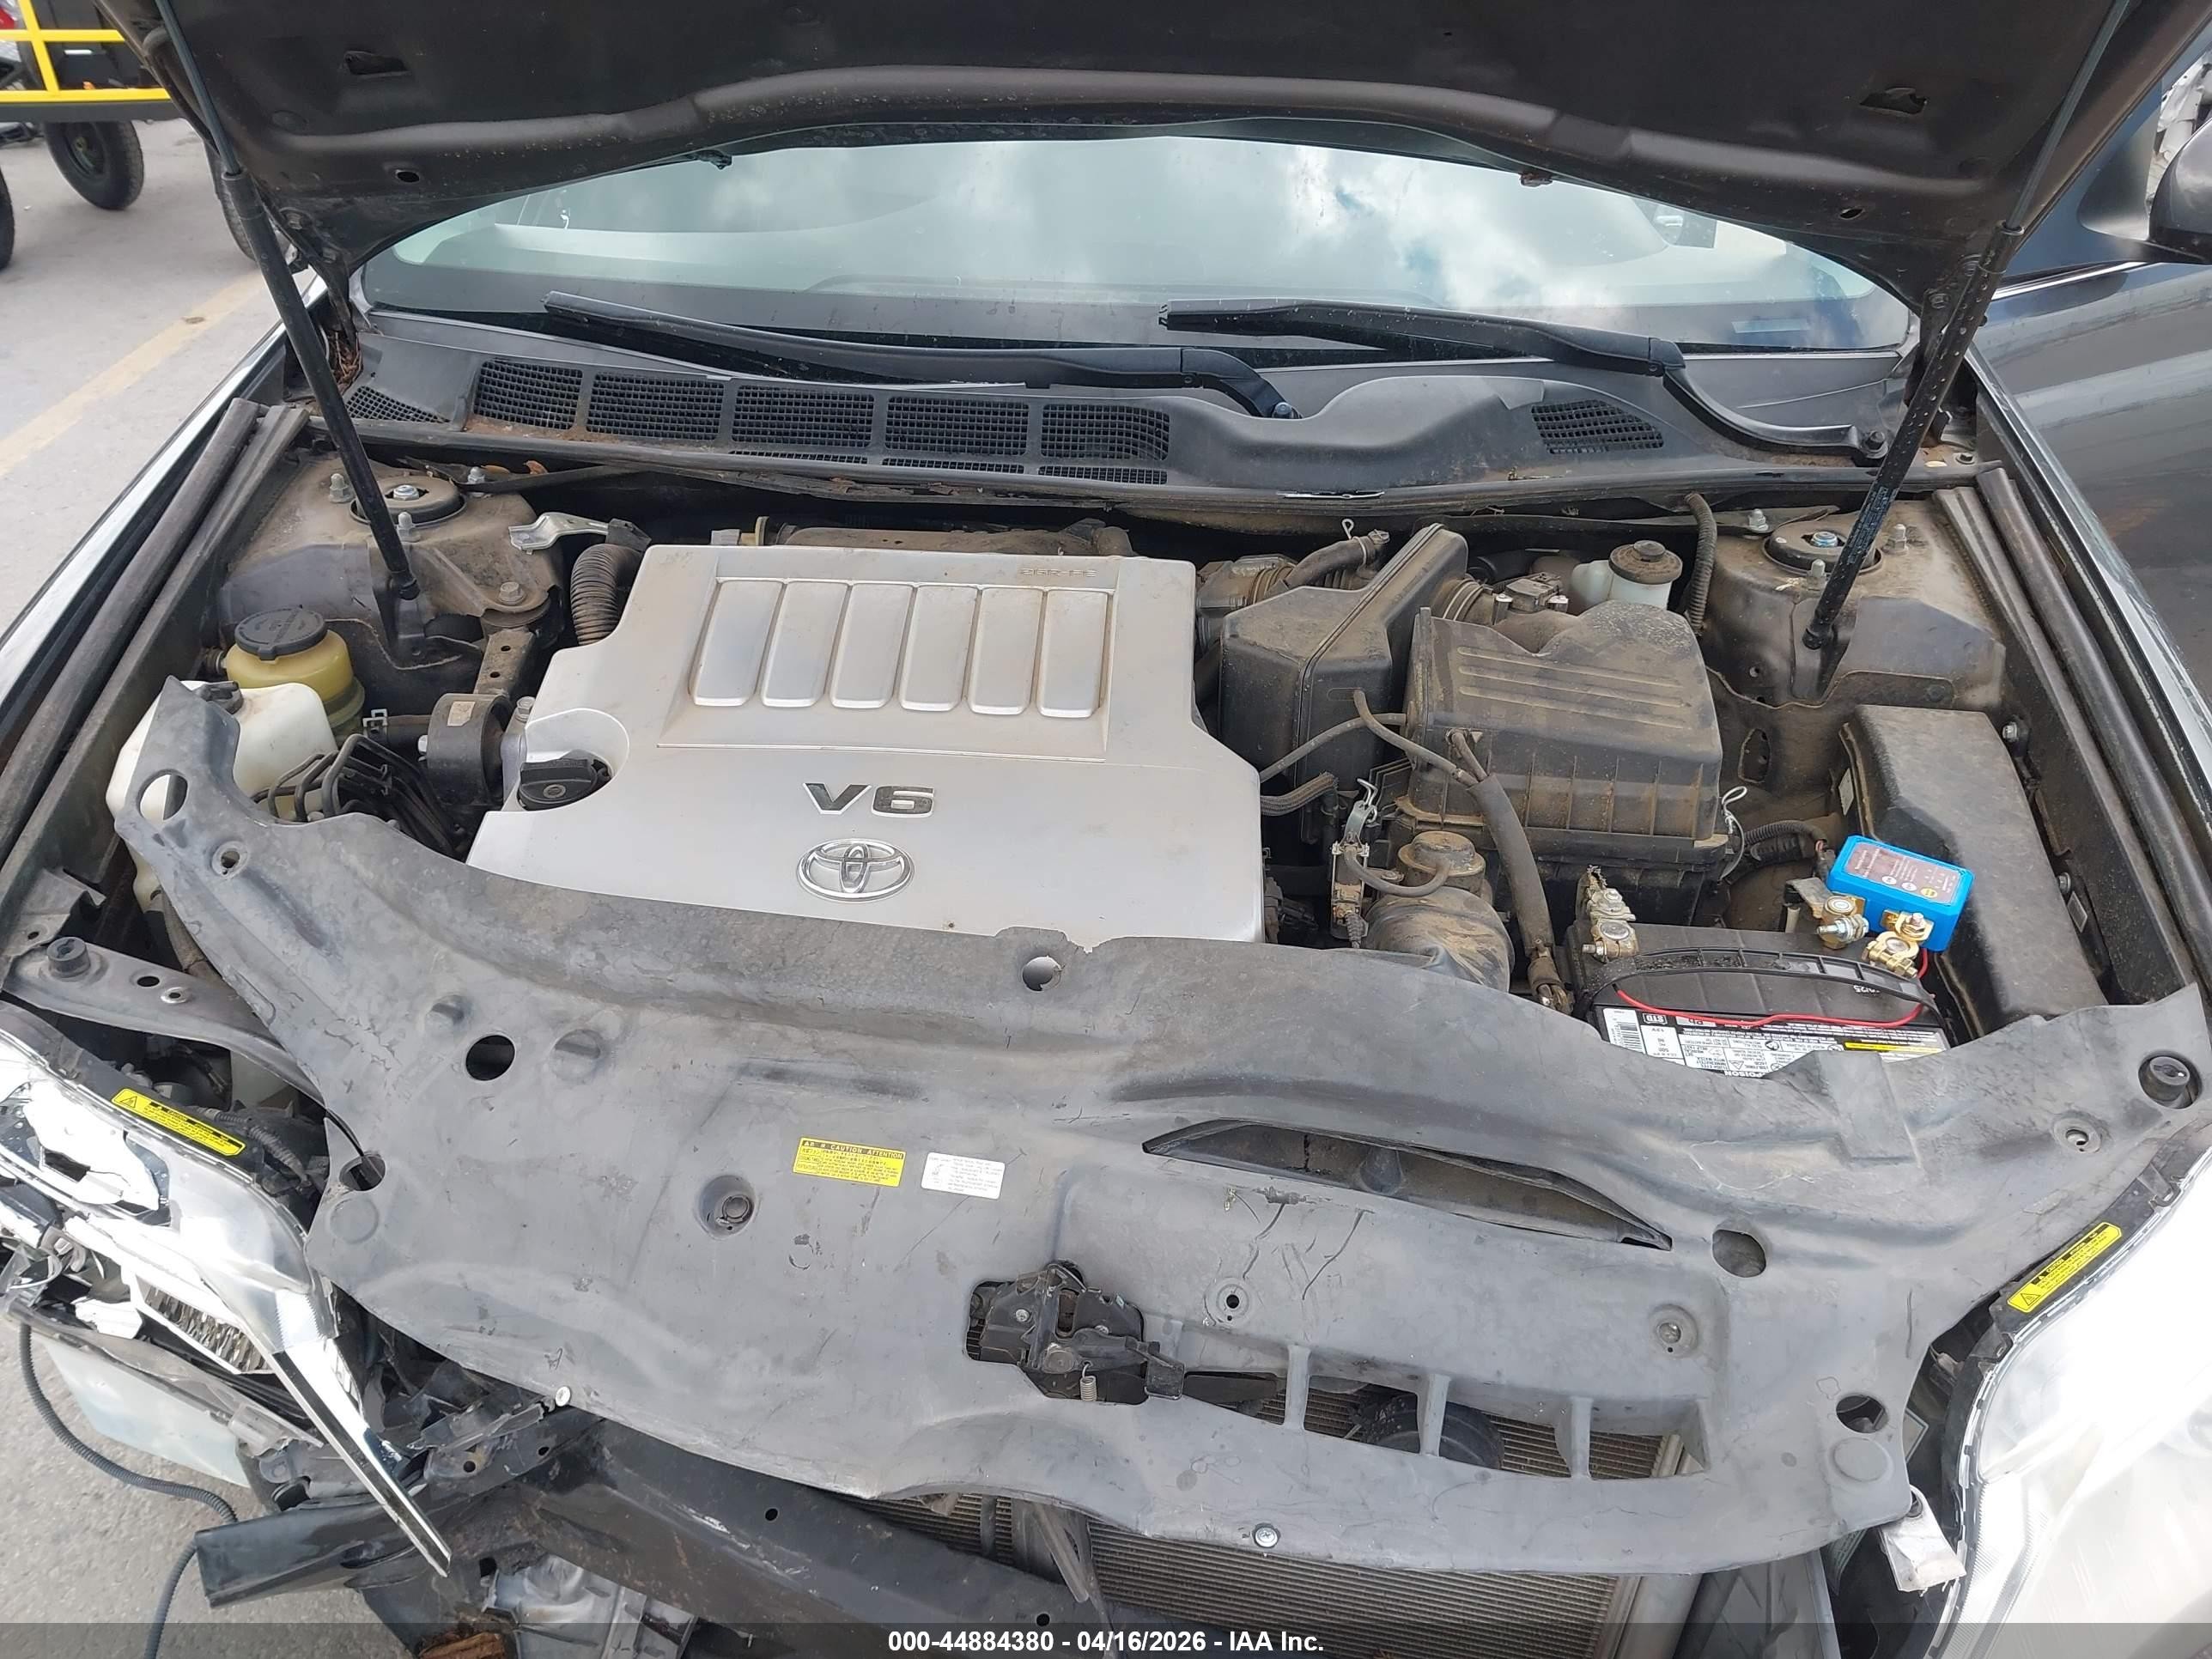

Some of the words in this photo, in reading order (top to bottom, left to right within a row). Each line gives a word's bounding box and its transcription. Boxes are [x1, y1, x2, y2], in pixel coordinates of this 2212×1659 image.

[803, 782, 935, 817] V6
[830, 1143, 862, 1153] CAUTION
[867, 1149, 902, 1159] ATTENTION
